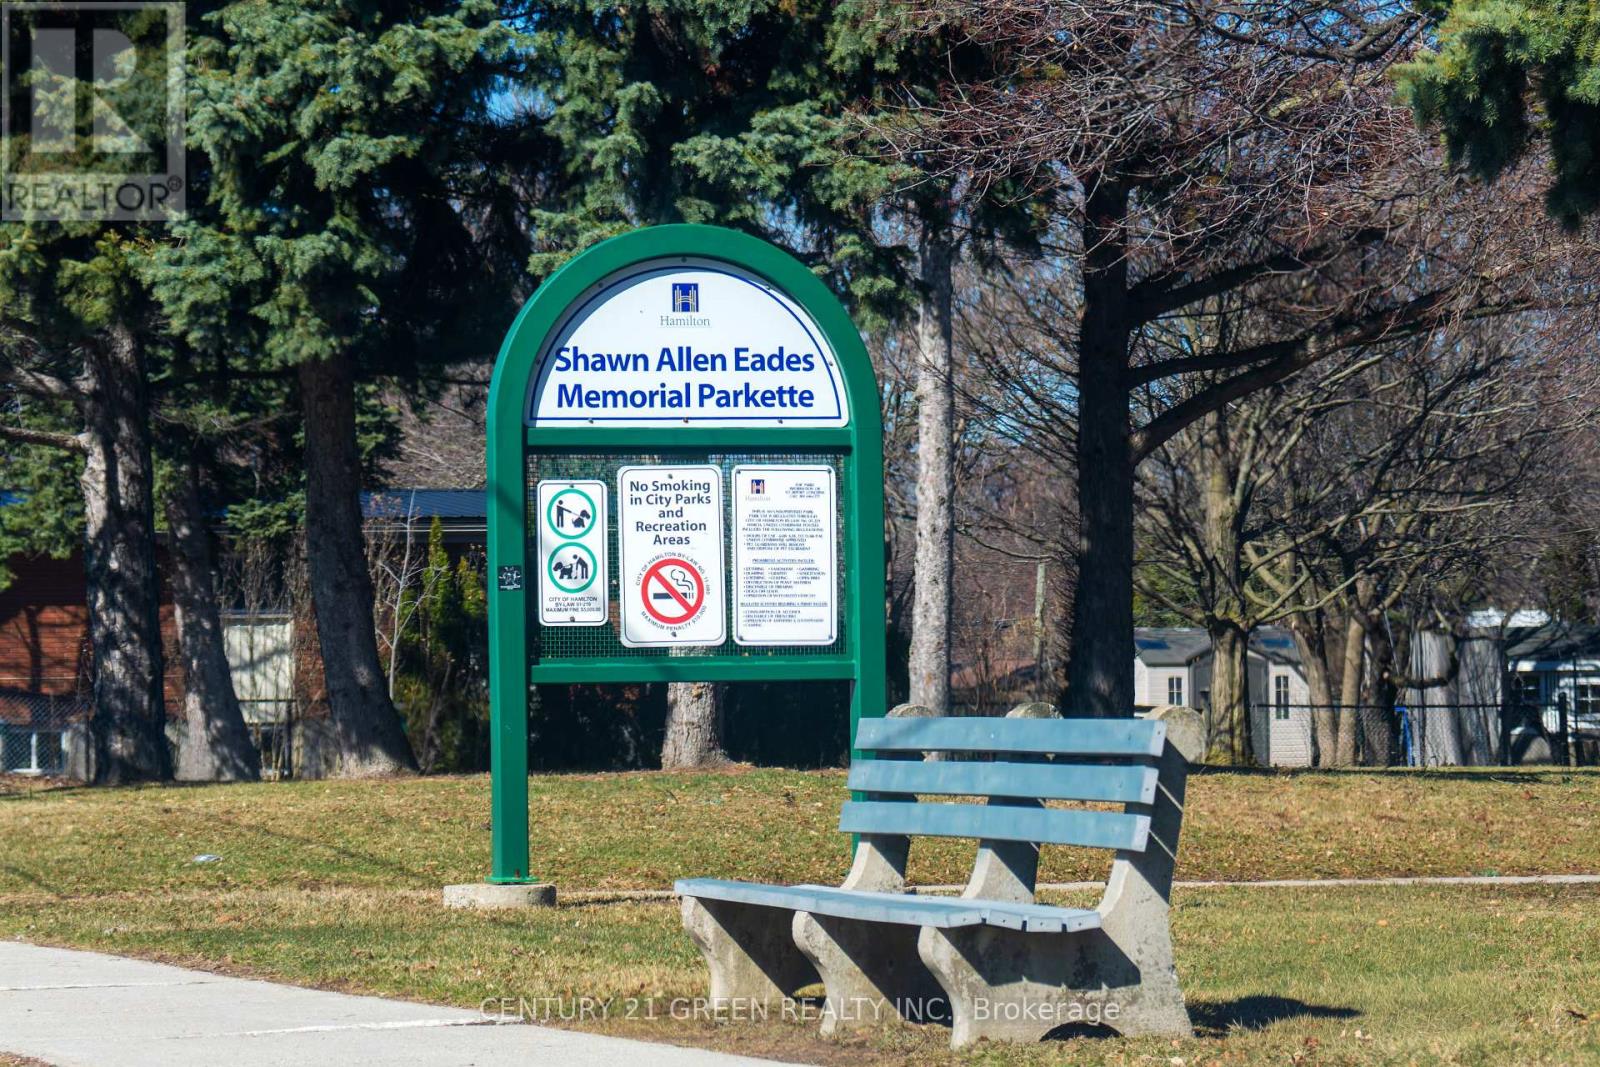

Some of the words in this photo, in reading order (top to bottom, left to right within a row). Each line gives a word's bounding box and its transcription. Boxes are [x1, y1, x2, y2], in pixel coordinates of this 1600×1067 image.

[660, 315, 710, 326] Hamilton
[555, 346, 649, 372] Shawn
[656, 346, 727, 372] Allen
[734, 346, 815, 372] Eades
[557, 382, 691, 408] Memorial
[699, 382, 814, 408] Parkette
[630, 481, 648, 492] No
[652, 480, 710, 493] Smoking
[630, 494, 642, 505] in
[646, 494, 671, 507] City
[675, 493, 711, 504] Parks
[658, 506, 683, 518] and
[636, 520, 706, 532] Recreation
[653, 534, 690, 545] Areas
